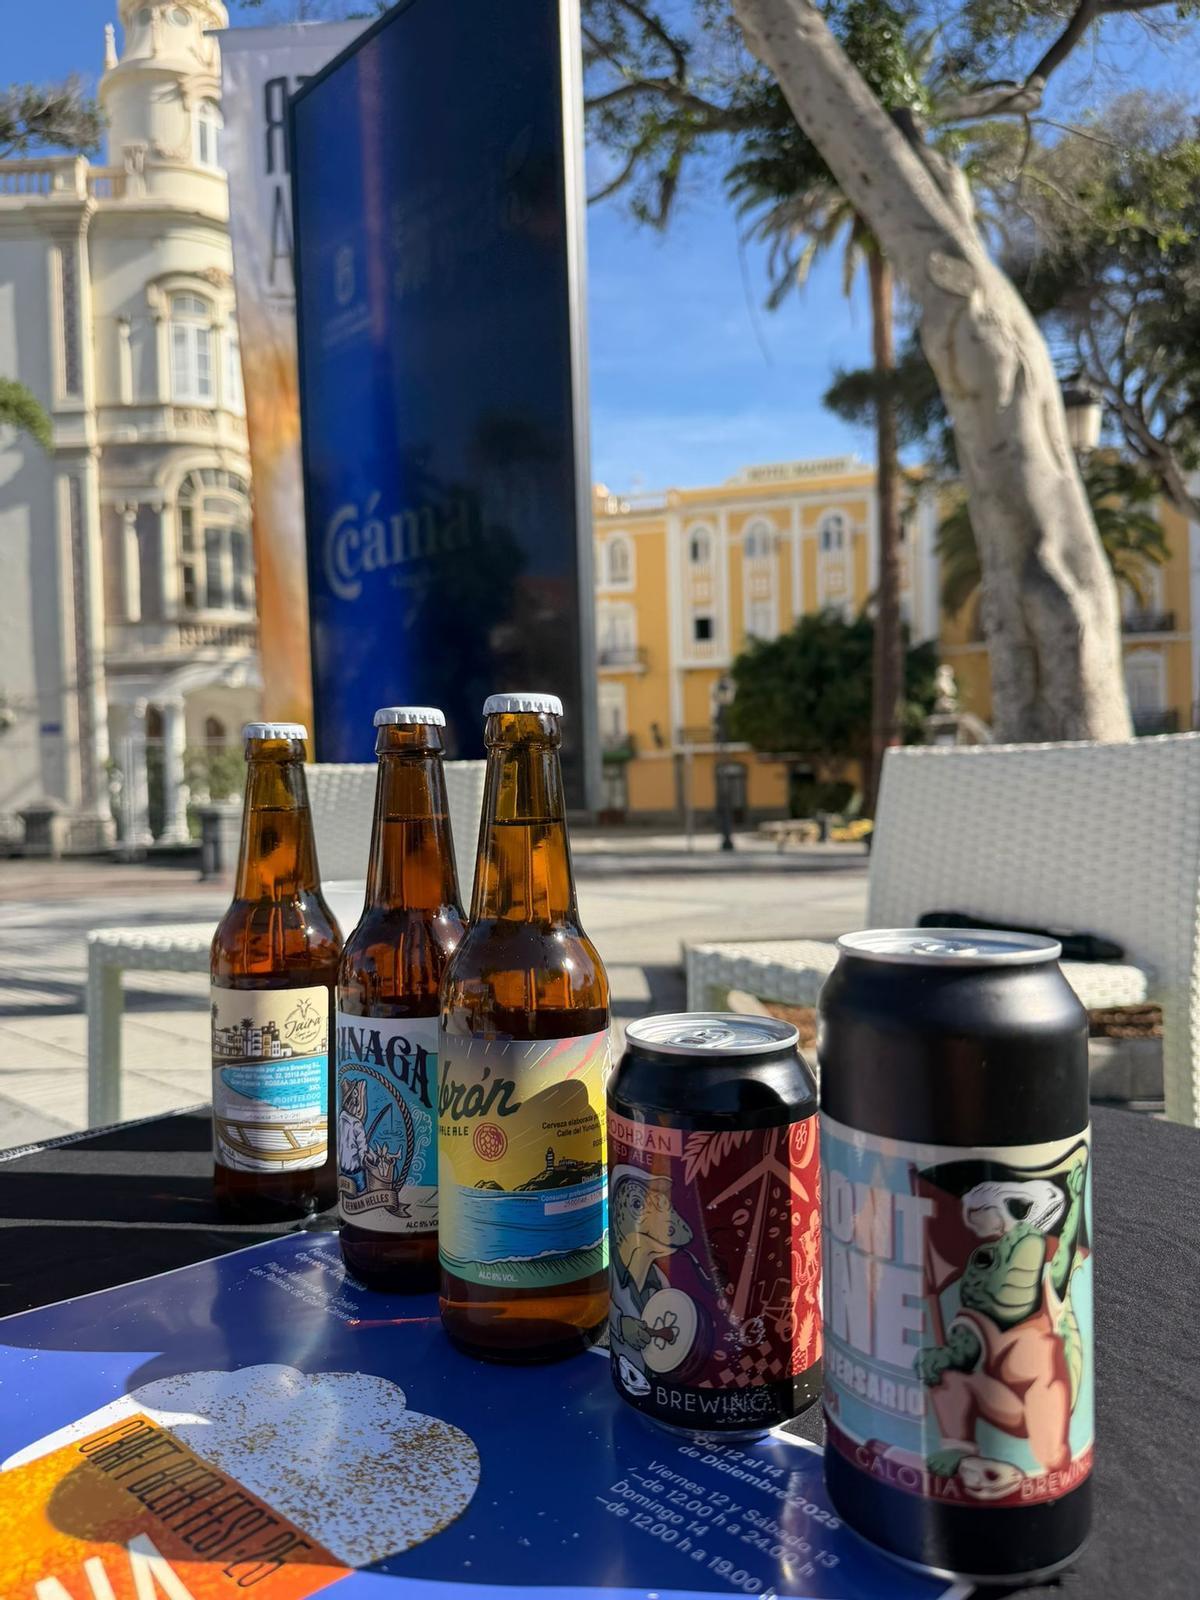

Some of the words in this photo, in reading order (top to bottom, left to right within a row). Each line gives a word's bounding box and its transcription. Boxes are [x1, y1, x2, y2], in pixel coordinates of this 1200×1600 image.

[323, 489, 478, 603] Cáma
[438, 1061, 522, 1121] brón
[452, 1126, 469, 1136] ALE
[542, 1120, 567, 1129] Cerveza
[608, 1118, 672, 1152] ODHRÁN
[631, 1151, 653, 1166] ALE
[656, 1386, 771, 1414] BREWING
[79, 1419, 186, 1481] CRAFT
[692, 1435, 726, 1453] Del
[724, 1450, 745, 1462] 12
[742, 1457, 764, 1468] al
[762, 1464, 785, 1478] 14
[127, 1458, 227, 1522] BEER
[609, 1479, 685, 1525] Domingo
[685, 1520, 710, 1537] 14
[648, 1460, 707, 1495] Viernes
[707, 1491, 730, 1506] 12
[724, 1503, 742, 1514] y
[742, 1508, 811, 1553] Sábado
[814, 1550, 840, 1568] 13
[677, 1444, 701, 1459] de
[700, 1454, 788, 1500] Diciembre
[787, 1496, 842, 1530] 2025
[173, 1491, 280, 1562] FEST
[630, 1512, 679, 1542] 12.00
[675, 1537, 692, 1552] h
[690, 1548, 707, 1562] a
[706, 1555, 763, 1593] 19.00
[665, 1489, 714, 1518] 12.00
[711, 1512, 727, 1527] h
[726, 1522, 741, 1535] a
[740, 1529, 800, 1565] 24.00
[798, 1561, 816, 1578] h
